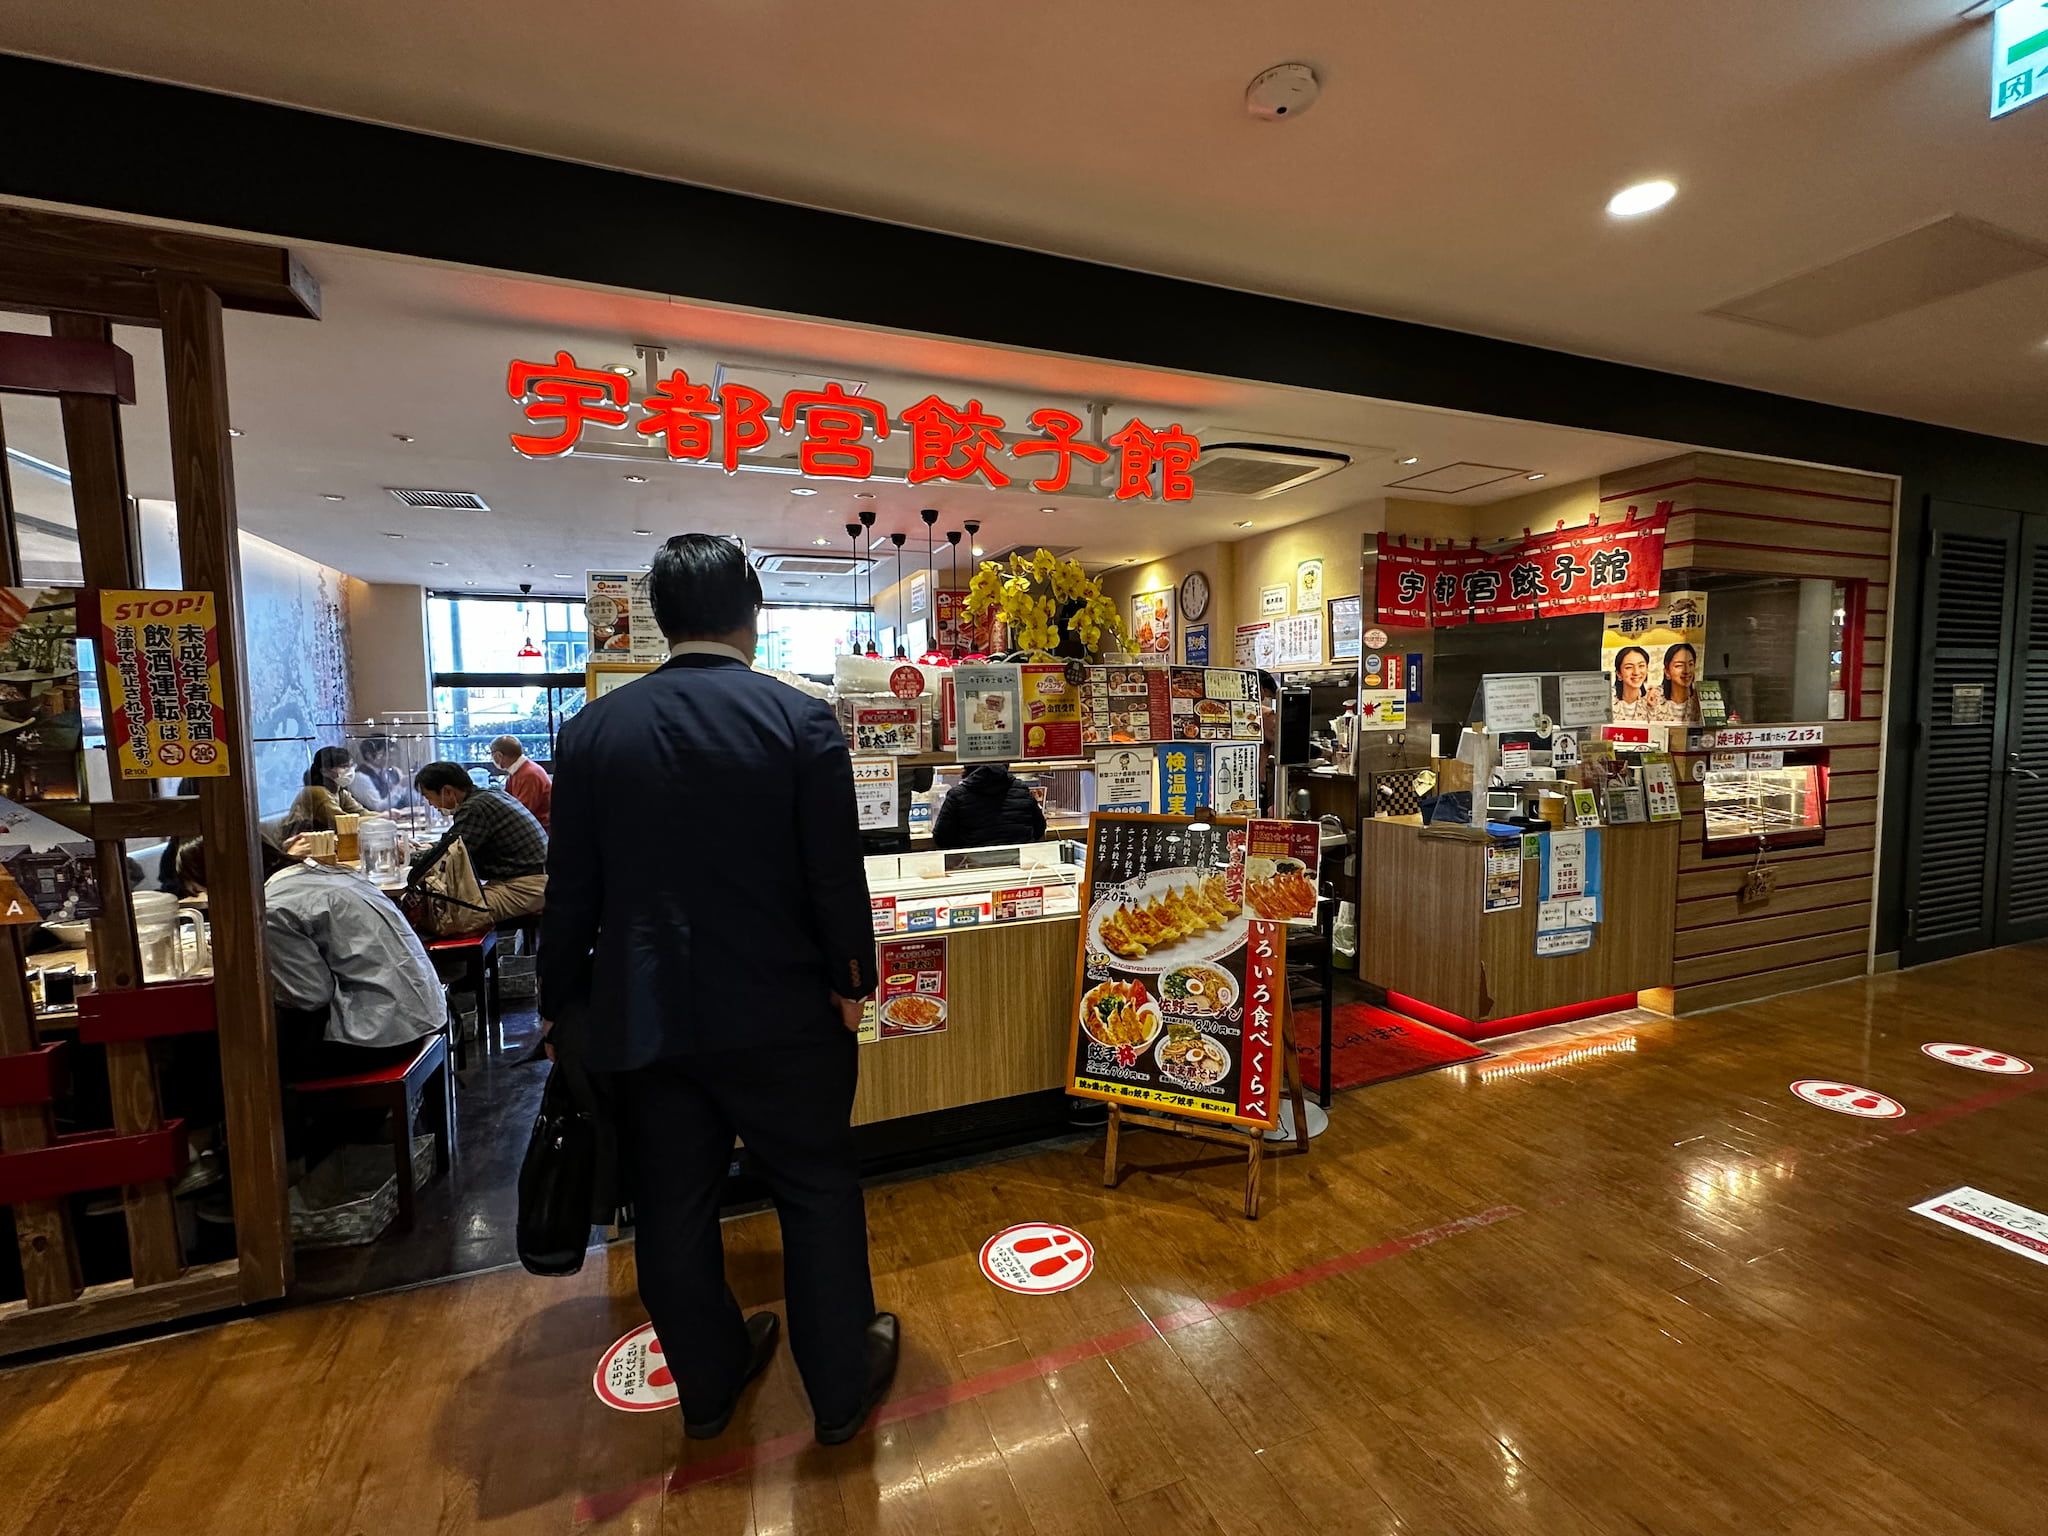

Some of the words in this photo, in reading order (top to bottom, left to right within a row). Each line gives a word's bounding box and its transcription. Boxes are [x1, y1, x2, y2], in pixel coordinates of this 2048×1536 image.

[507, 350, 1201, 503] 宇都宮餃子館
[1398, 547, 1632, 606] 宇都宮餃子館
[114, 596, 205, 621] STOP!
[116, 625, 153, 767] 法律で禁止されています。
[143, 624, 182, 741] 飲酒運転は
[177, 624, 215, 741] 未成年者飲酒
[853, 767, 890, 778] スクする
[1098, 827, 1108, 862] エビ餃子
[1111, 826, 1122, 870] チーズ餃子
[1168, 830, 1177, 862] ニ餃子
[1158, 998, 1243, 1022] 佐野ラーメン
[1245, 921, 1276, 1118] いろいろ食べくらべ
[611, 1357, 624, 1387] こちらで
[624, 1342, 637, 1396] お待ちください
